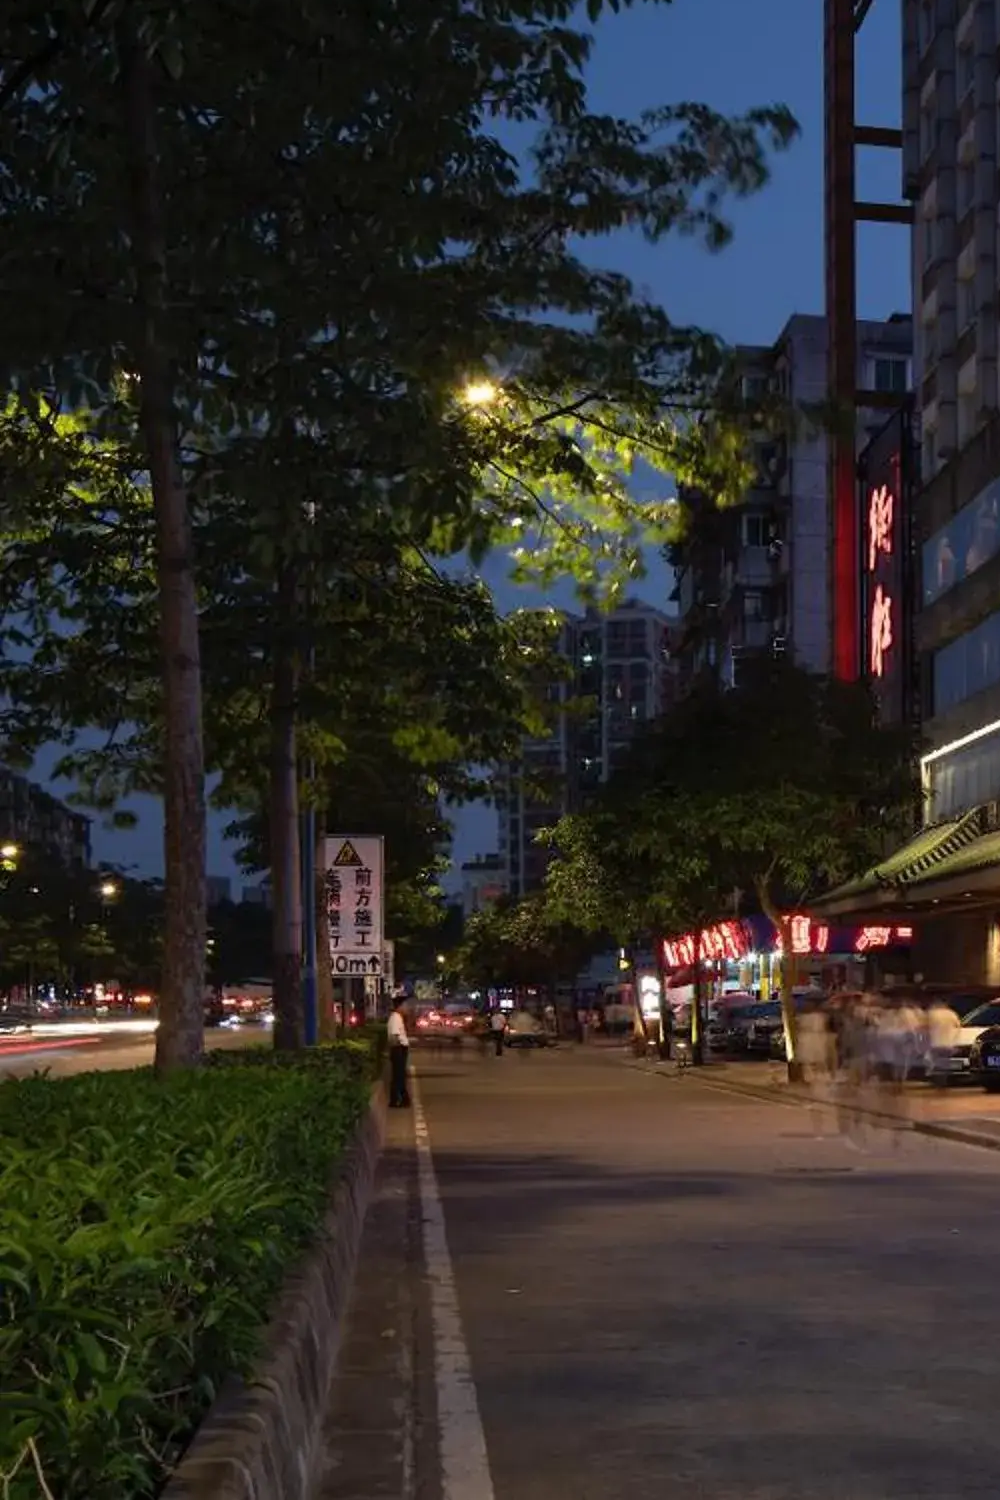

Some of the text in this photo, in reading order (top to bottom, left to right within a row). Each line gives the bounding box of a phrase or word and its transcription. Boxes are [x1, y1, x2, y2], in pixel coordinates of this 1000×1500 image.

[354, 868, 373, 947] 前方施工
[331, 955, 367, 973] 0m
